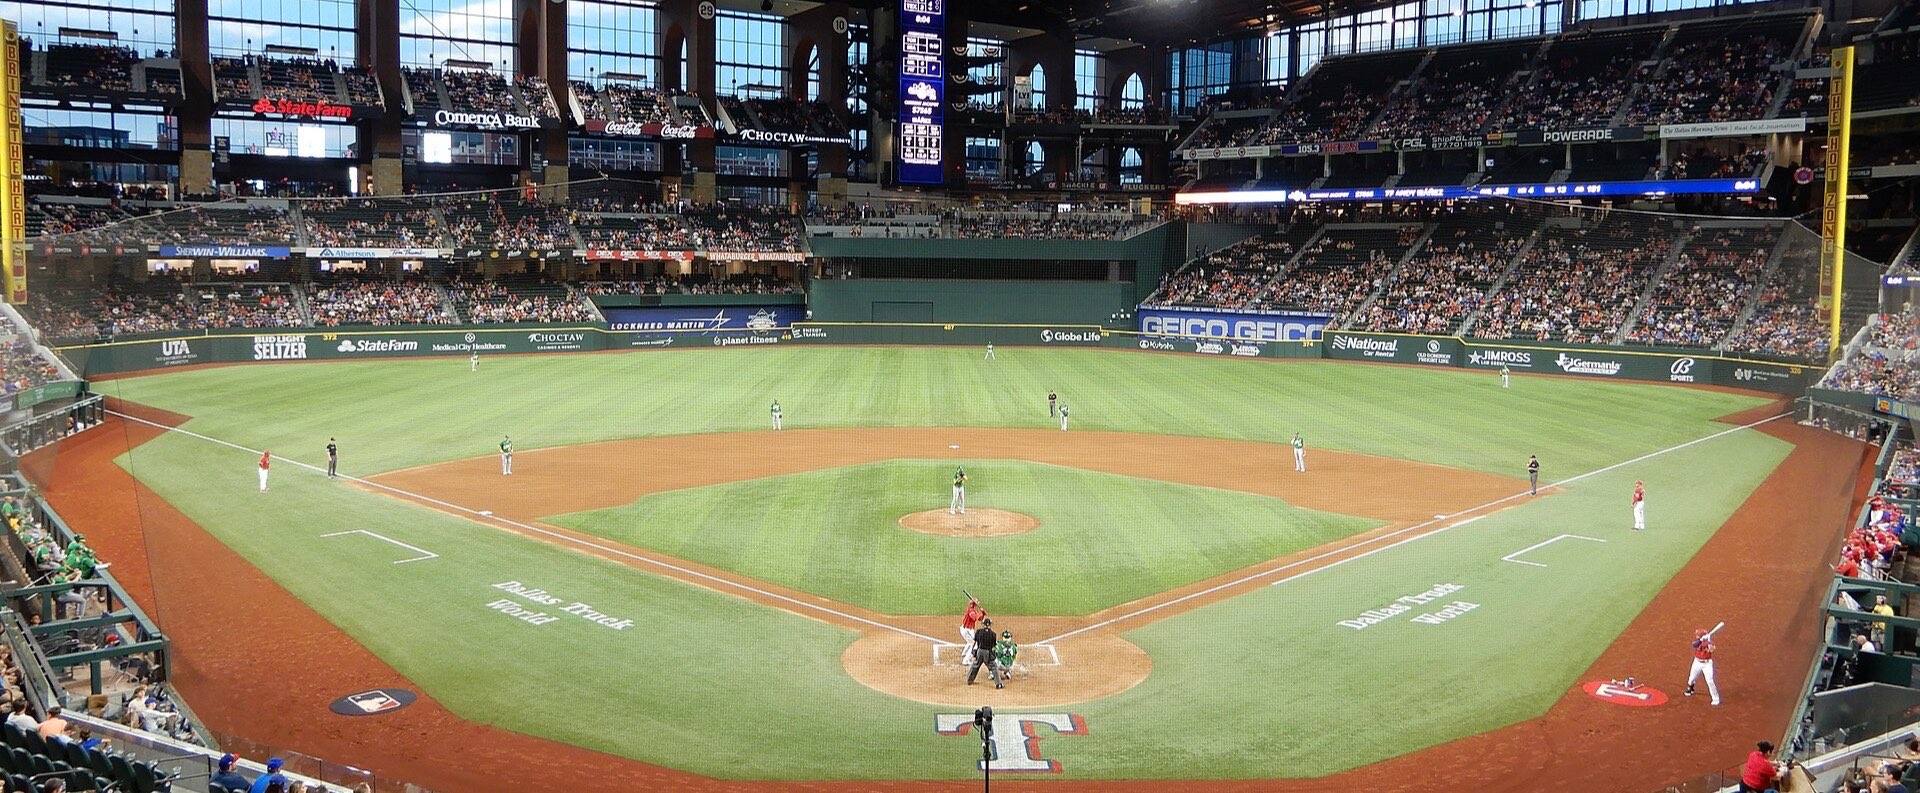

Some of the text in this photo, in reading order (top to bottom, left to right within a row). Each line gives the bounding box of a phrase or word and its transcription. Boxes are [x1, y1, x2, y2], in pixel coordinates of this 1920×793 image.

[700, 4, 713, 16] 29
[836, 20, 845, 31] 10
[505, 114, 541, 128] Bank
[746, 129, 805, 143] CHOCTAW
[1543, 130, 1612, 142] POWERADE
[8, 45, 22, 240] BRING THE HEAT
[1298, 144, 1320, 153] 105.3
[1402, 138, 1426, 147] PGL
[1824, 80, 1841, 253] THE HOT ZONE
[709, 252, 803, 261] WHATABURGER WHATABURGER
[611, 321, 705, 330] LOCKHEED MARTIN
[1143, 316, 1229, 339] GEICO
[534, 333, 584, 342] CHOCTAW
[722, 334, 778, 346] planet fitness
[1055, 331, 1100, 341] Globe Life
[162, 340, 190, 356] UTA
[254, 343, 307, 360] SELTZER
[432, 343, 458, 351] Medical
[458, 343, 471, 351] City
[1573, 358, 1621, 371] Germania
[1670, 374, 1694, 382] SPORTS
[491, 580, 635, 630] Dallas Truck
[1336, 583, 1465, 630] Dallas Truck
[486, 599, 560, 625] World
[1410, 601, 1481, 624] World
